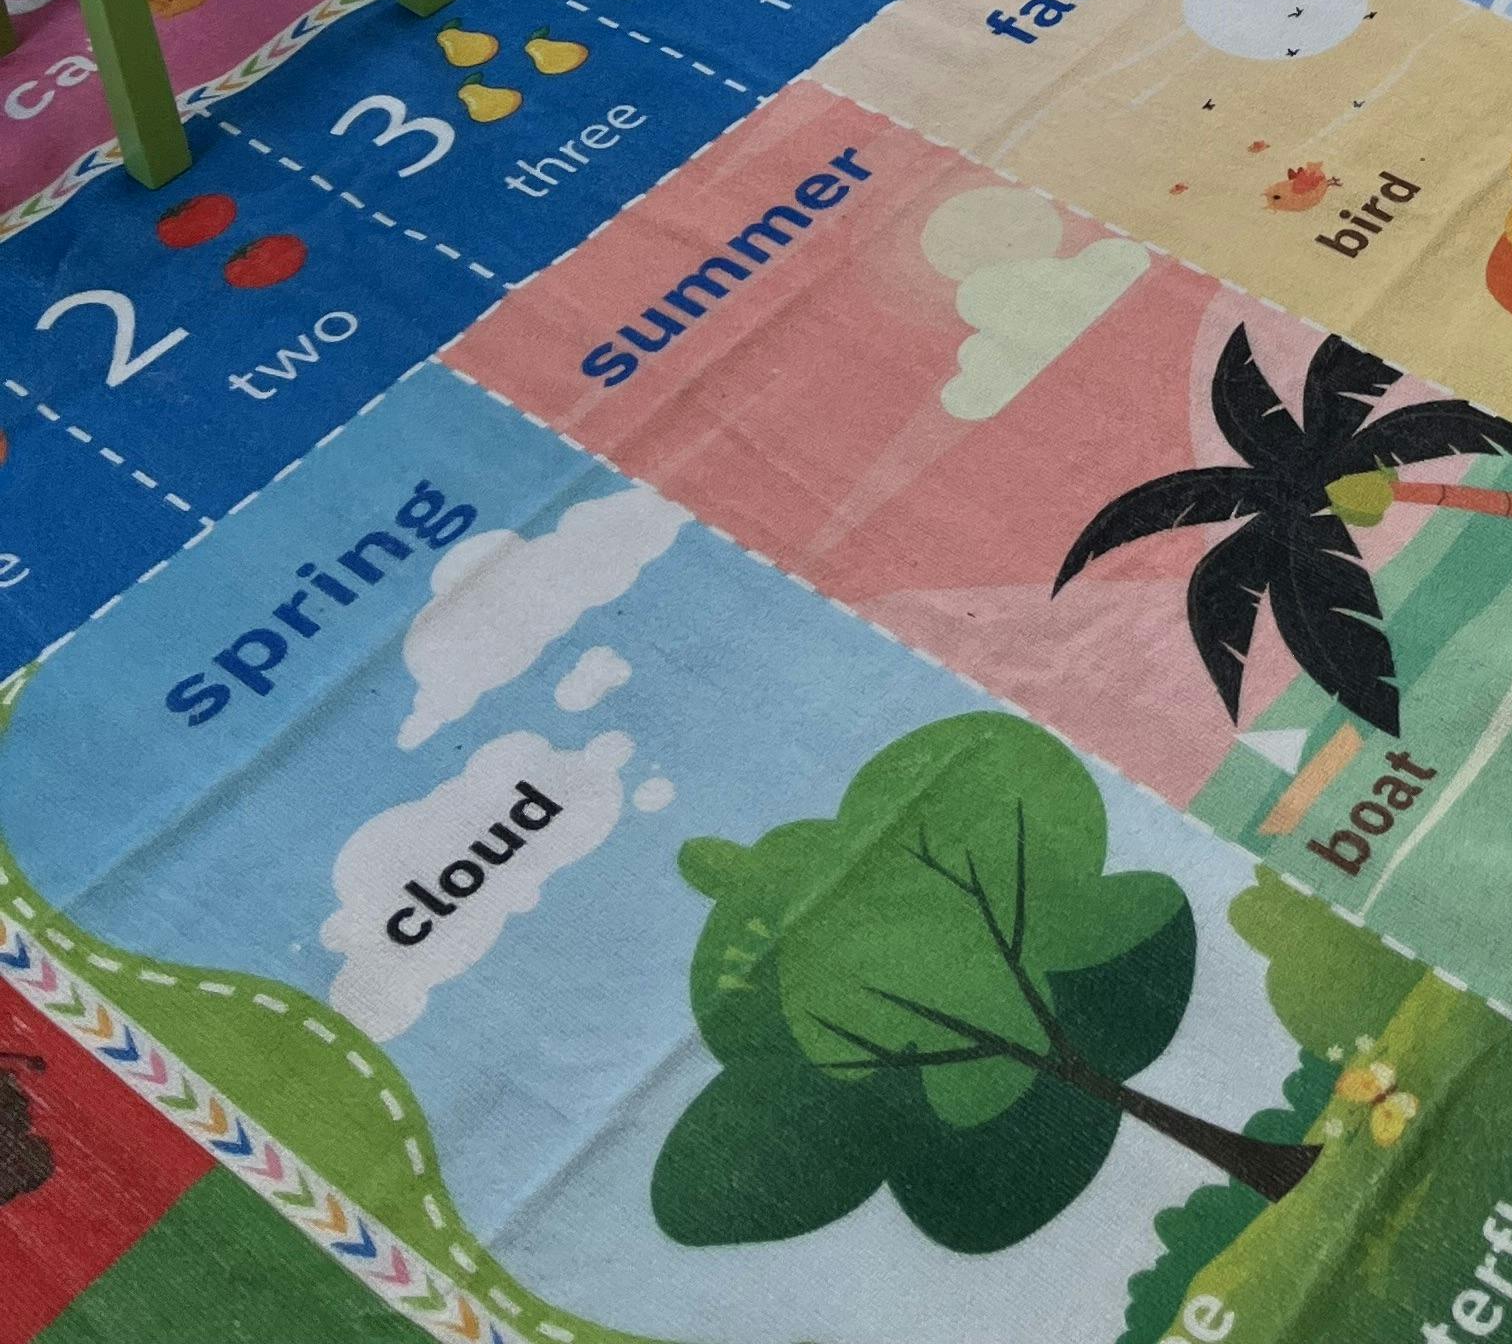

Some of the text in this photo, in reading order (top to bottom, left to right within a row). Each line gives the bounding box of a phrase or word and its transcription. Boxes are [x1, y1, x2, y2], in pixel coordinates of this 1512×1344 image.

[5, 39, 98, 120] ca
[329, 95, 456, 177] 3
[504, 101, 647, 198] three
[1315, 171, 1421, 258] bird
[581, 146, 873, 389] summer
[35, 289, 190, 387] 2
[228, 311, 359, 400] two
[165, 479, 479, 727] spring
[1307, 750, 1437, 877] boat
[385, 780, 564, 947] cloud
